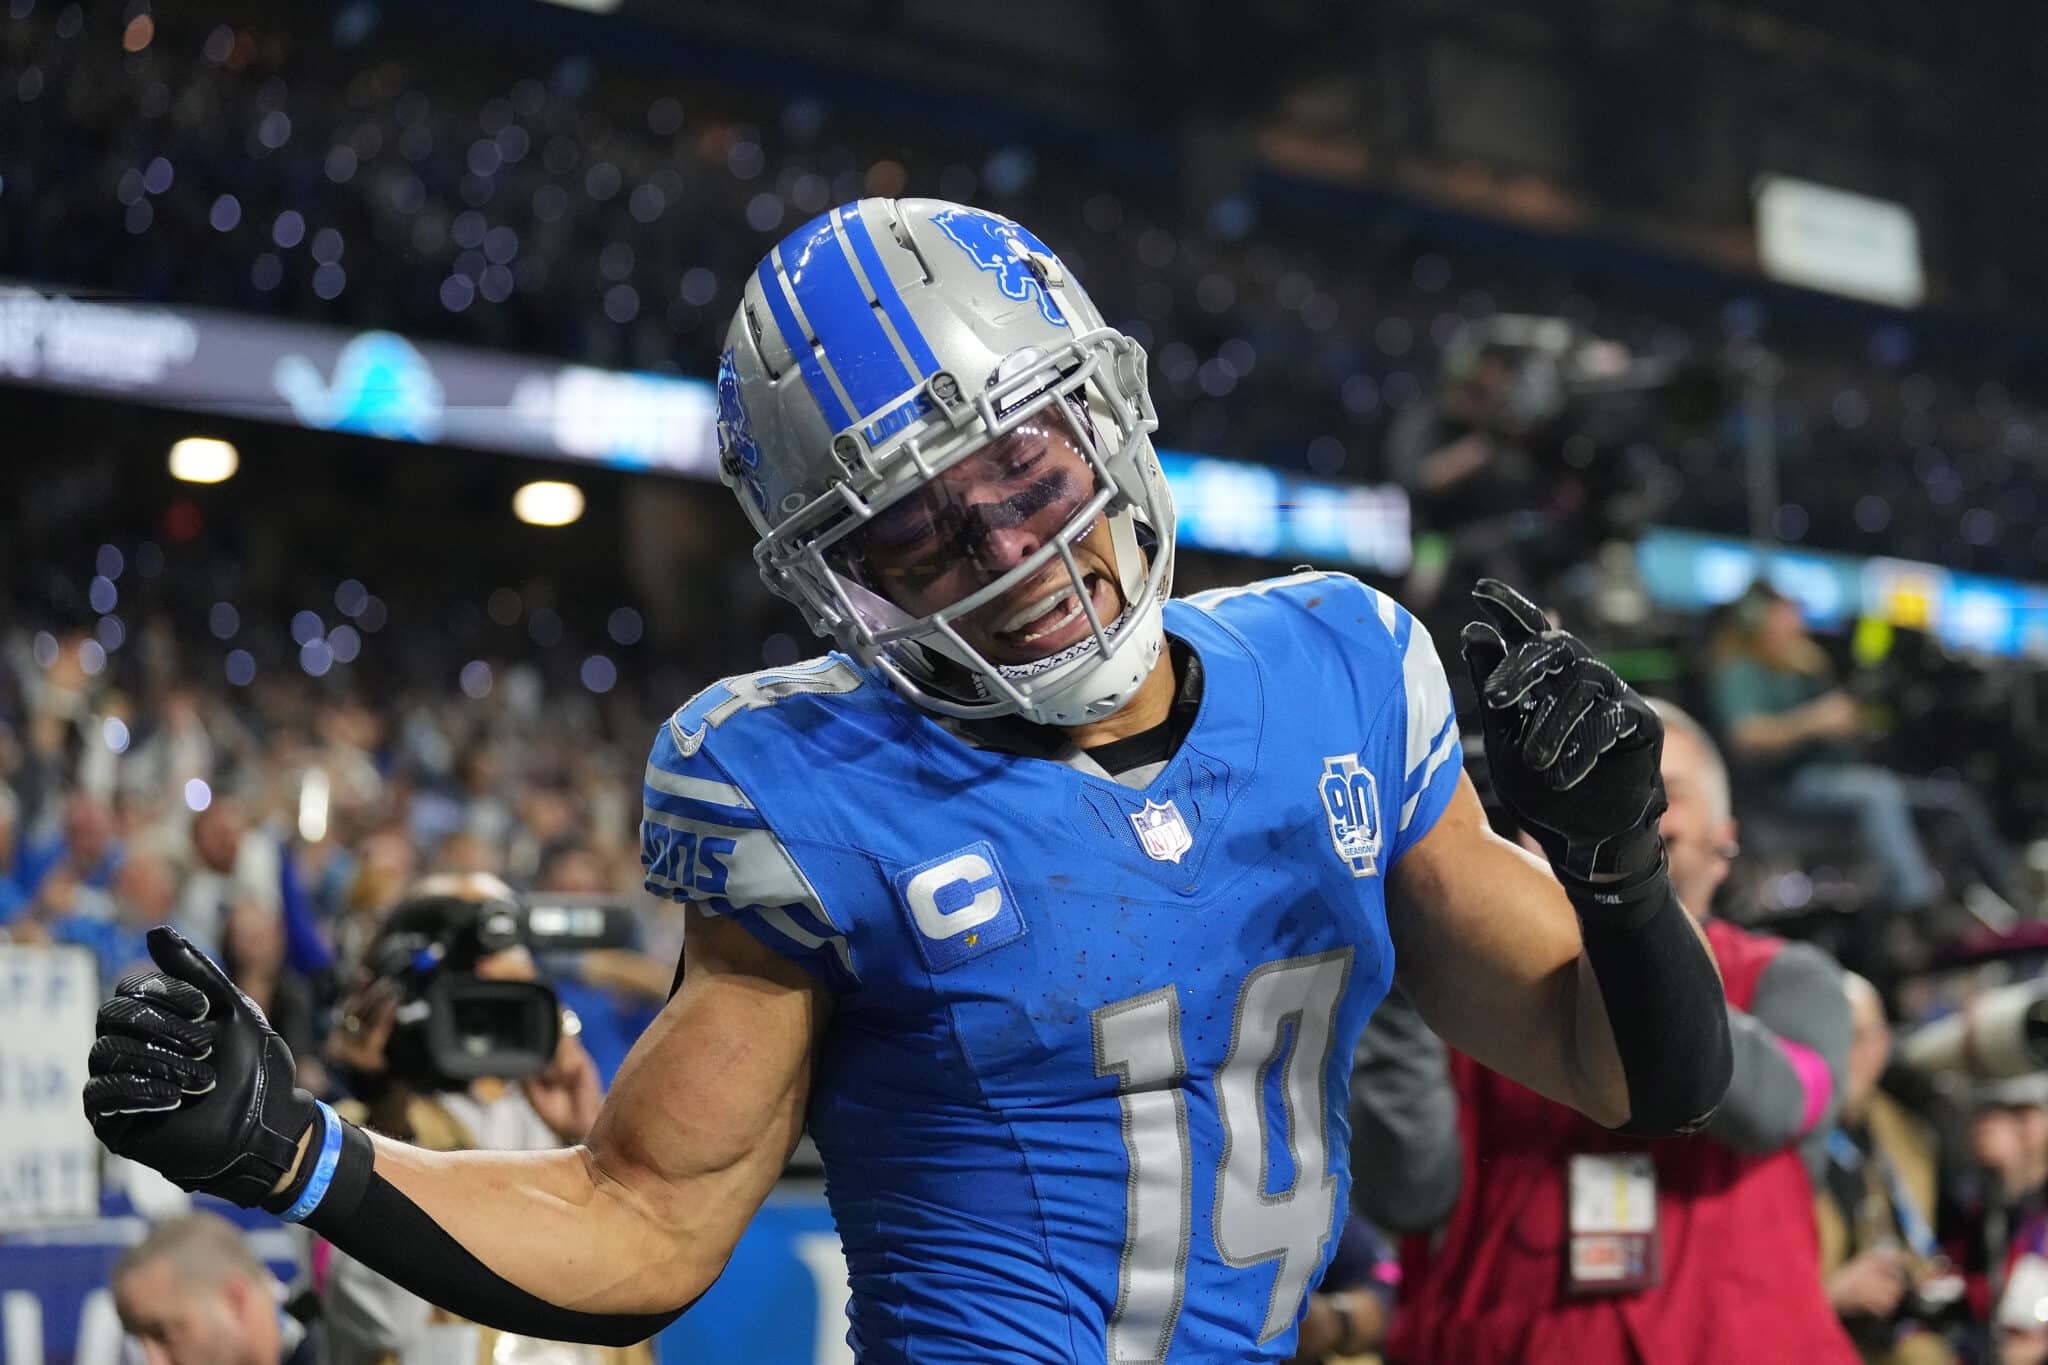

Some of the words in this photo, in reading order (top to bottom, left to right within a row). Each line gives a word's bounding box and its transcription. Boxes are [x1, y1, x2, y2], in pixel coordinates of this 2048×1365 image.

[864, 391, 933, 447] LIONS
[1324, 772, 1378, 842] 90
[1343, 845, 1377, 856] SEASONS
[906, 854, 1002, 940] C
[1089, 945, 1356, 1365] 14
